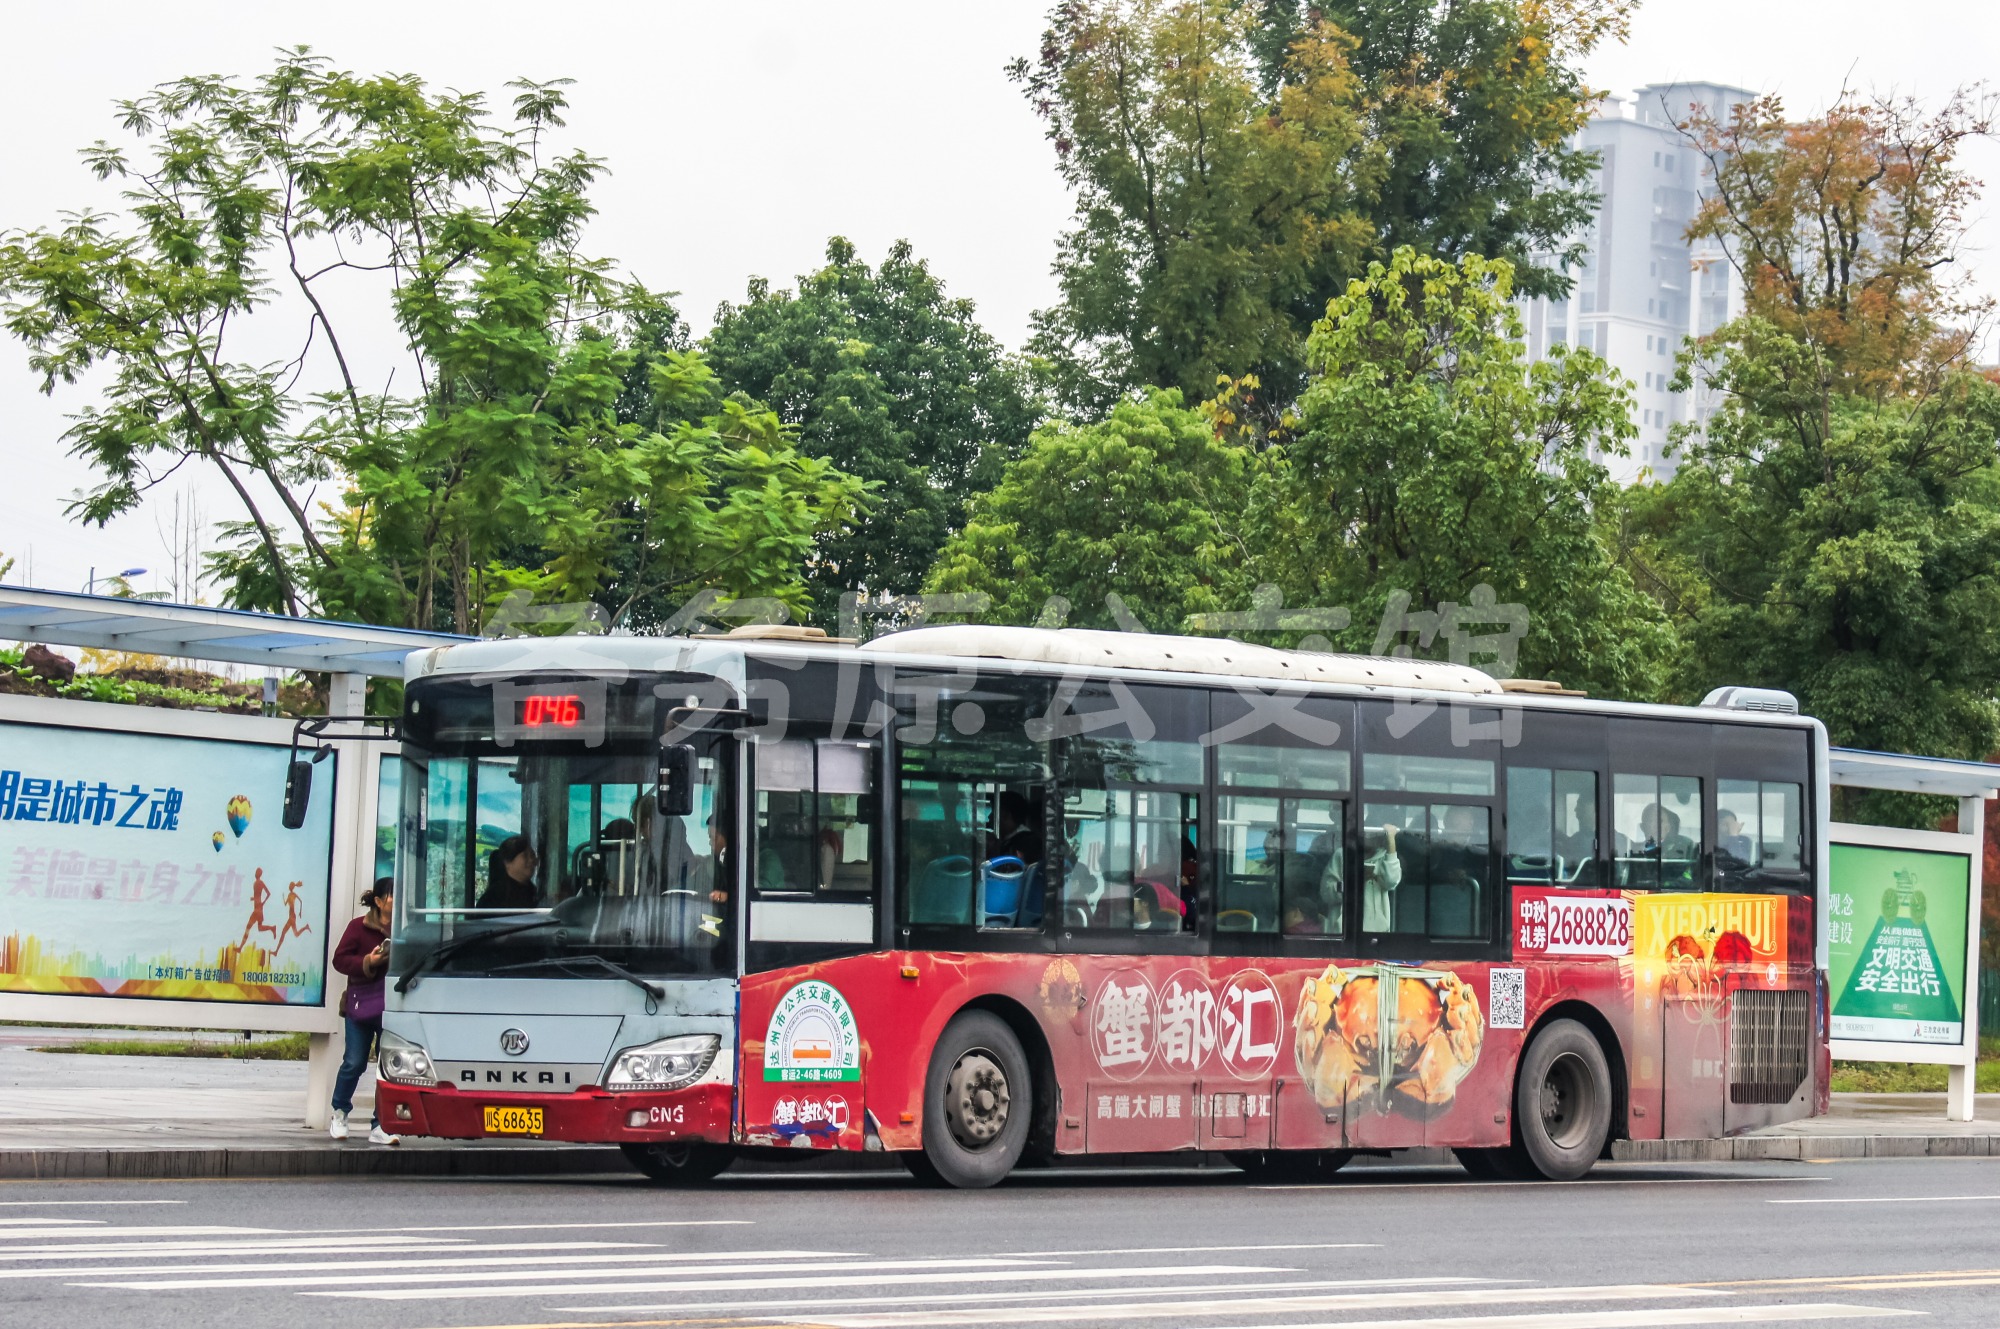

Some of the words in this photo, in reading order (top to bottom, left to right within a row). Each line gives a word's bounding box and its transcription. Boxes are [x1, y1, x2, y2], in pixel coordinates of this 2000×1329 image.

[525, 695, 579, 726] 046
[7, 846, 246, 907] 美德是立身之本
[1519, 925, 1547, 949] 礼券
[1520, 900, 1547, 923] 中秋
[1550, 904, 1629, 947] 2688828
[1648, 899, 1771, 956] XIEDUHUI
[1866, 946, 1935, 972] 文明交通
[1855, 969, 1940, 996] 安全出行
[769, 984, 854, 1067] 达州市公共交通有限公司
[1097, 980, 1277, 1071] 蟹都汇
[461, 1069, 570, 1084] ANKAI
[650, 1104, 684, 1123] CNG
[1097, 1095, 1181, 1119] 高端大闸蟹
